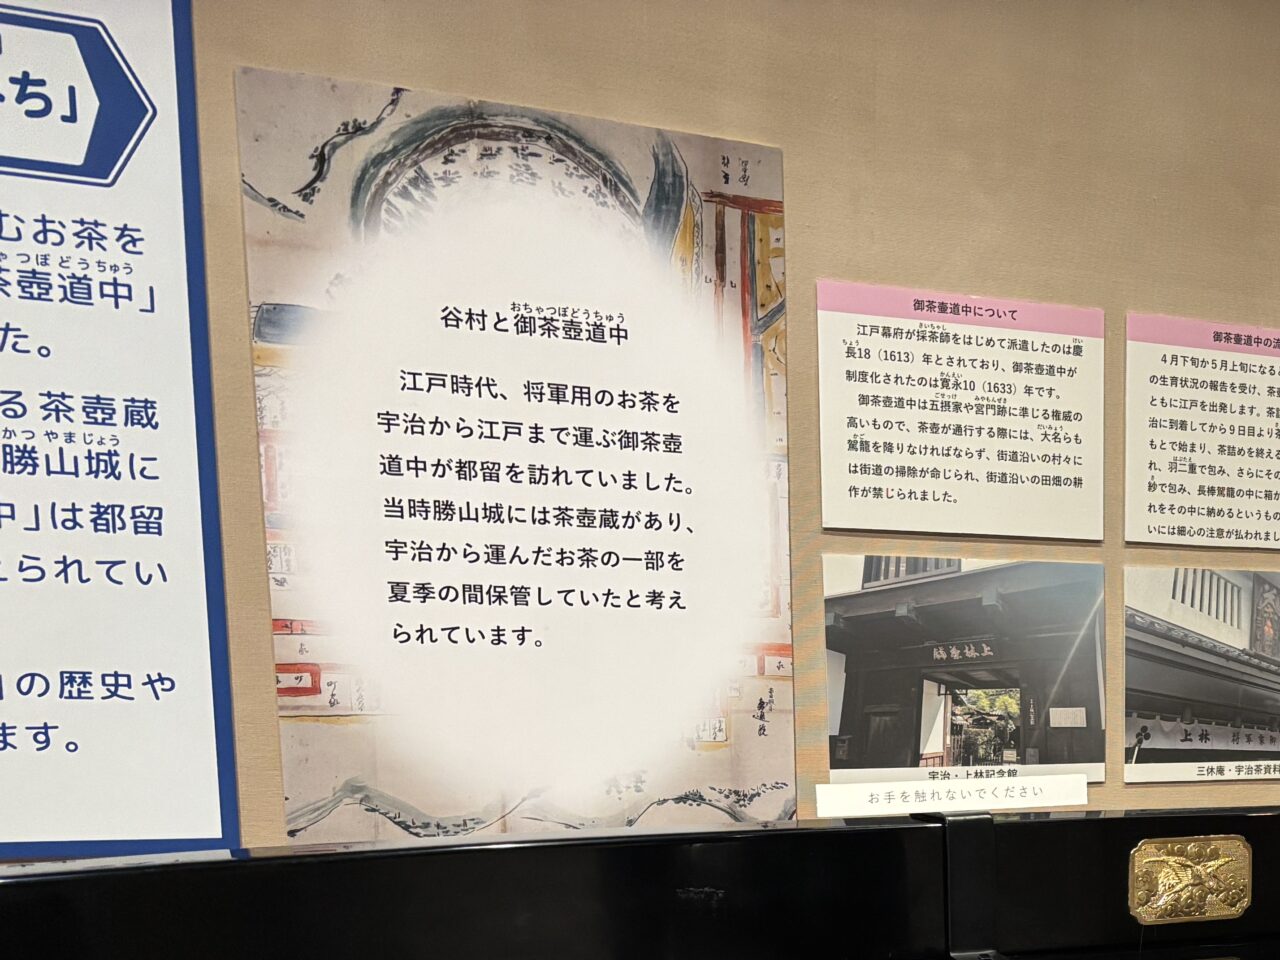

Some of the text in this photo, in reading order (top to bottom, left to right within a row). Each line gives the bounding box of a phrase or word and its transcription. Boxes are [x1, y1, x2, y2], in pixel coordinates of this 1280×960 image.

[0, 71, 78, 124] ち」
[440, 305, 630, 347] 谷村と御茶壺道中
[510, 301, 626, 325] おちゃつぼどうちゅう
[856, 323, 1084, 358] 江戸幕府が採茶師をはじめて派遣したのは慶
[399, 369, 681, 414] 江戸時代、将軍用のお茶を
[2, 426, 121, 447] かつやまじょう
[376, 410, 684, 455] 宇治から江戸まで運ぶ御茶壺
[2, 442, 161, 481] 勝山城に
[379, 453, 694, 496] 道中が都留を訪れていました。
[847, 462, 1084, 489] は街道の掃除が命じられ、街道沿いの田畑の耕
[848, 485, 959, 504] 作が禁じられました。
[383, 496, 696, 535] 当時勝山城には茶壺蔵があり、
[0, 555, 168, 586] られてい
[384, 538, 686, 572] 宇治から運んだお茶の一部を
[387, 580, 687, 611] 夏季の間保管していたと考え
[392, 622, 544, 648] られています。
[0, 670, 176, 701] の歴史や
[867, 785, 1043, 805] お手を触れないでください
